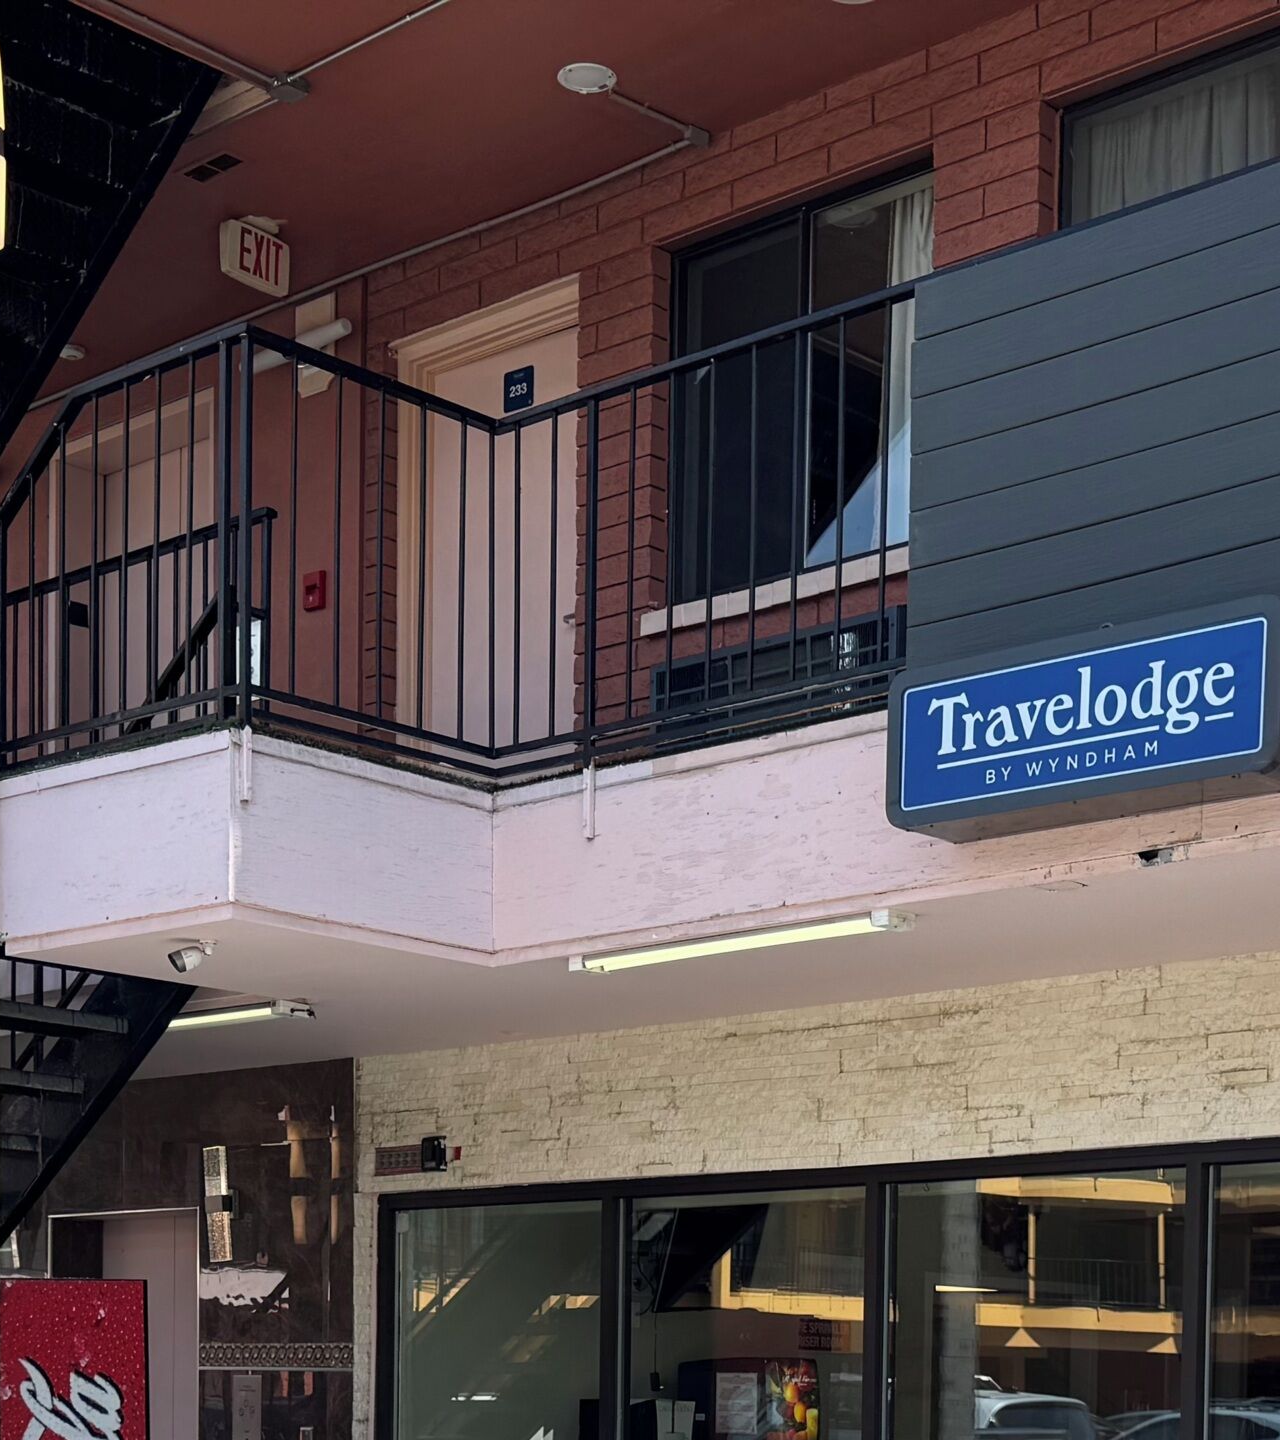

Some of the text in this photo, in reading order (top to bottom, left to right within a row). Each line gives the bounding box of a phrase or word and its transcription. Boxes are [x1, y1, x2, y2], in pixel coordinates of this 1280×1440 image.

[239, 226, 283, 287] EXIT
[509, 382, 528, 398] 233
[928, 660, 1236, 756] Travelodge
[985, 740, 1159, 784] BY WYNDHAM
